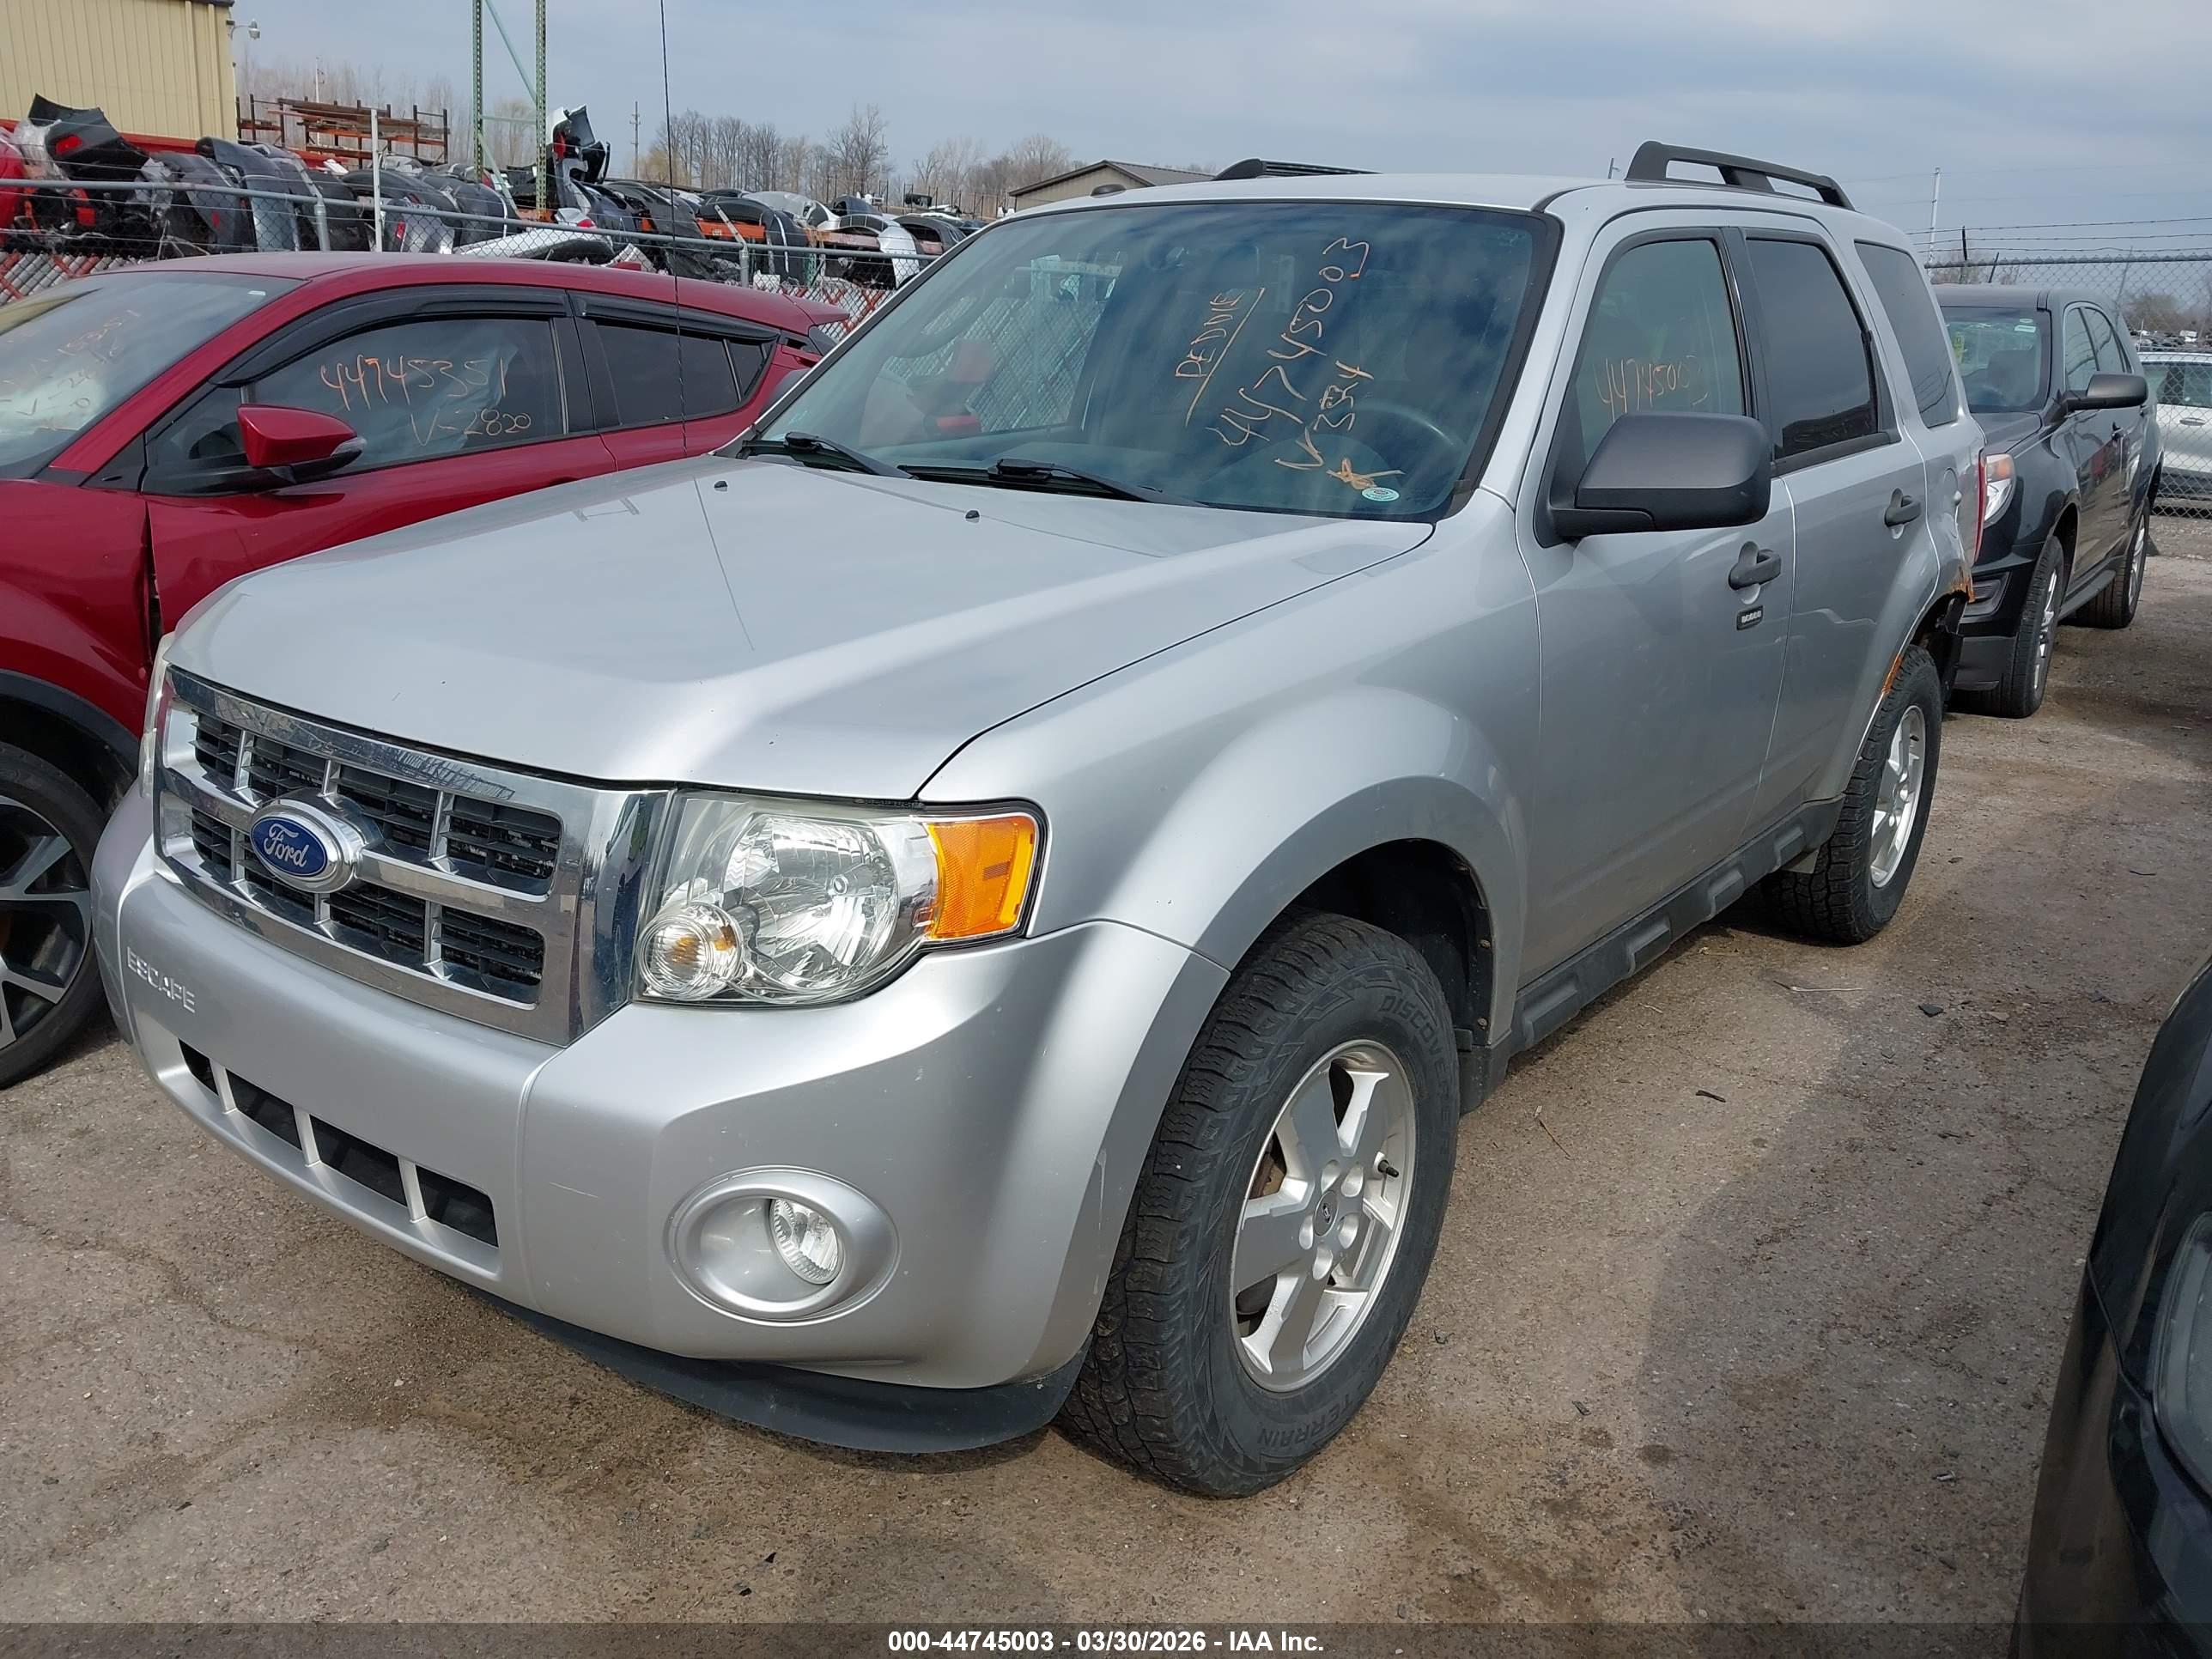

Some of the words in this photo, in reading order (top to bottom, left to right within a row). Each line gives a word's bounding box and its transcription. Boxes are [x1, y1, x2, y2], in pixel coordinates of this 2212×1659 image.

[1205, 238, 1370, 447] 44745003
[320, 354, 507, 412] 44745351
[264, 823, 309, 868] Ford
[127, 945, 196, 1014] ESCAPE
